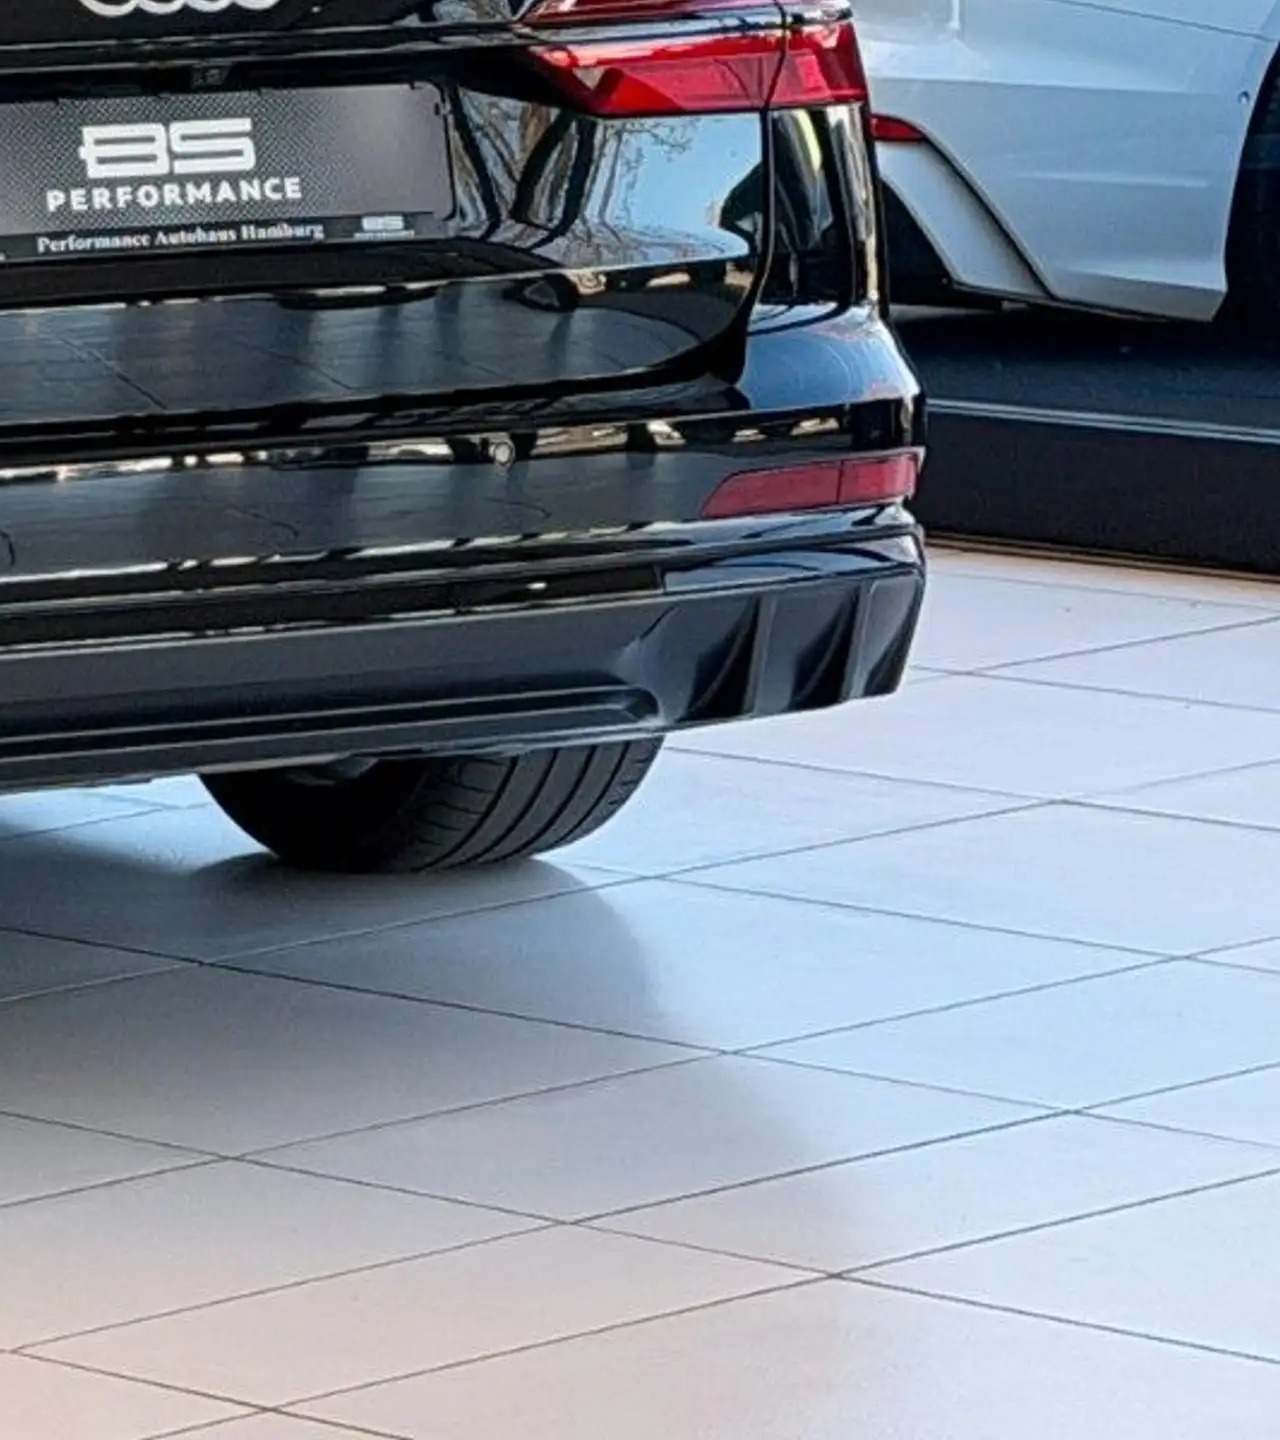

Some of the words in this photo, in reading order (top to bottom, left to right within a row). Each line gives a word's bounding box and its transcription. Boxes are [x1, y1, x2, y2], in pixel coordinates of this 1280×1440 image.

[77, 117, 256, 179] BS
[45, 177, 303, 212] PERFORMANCE
[37, 234, 151, 254] Performance
[154, 228, 237, 246] Autohaus
[241, 221, 325, 242] Hamburg
